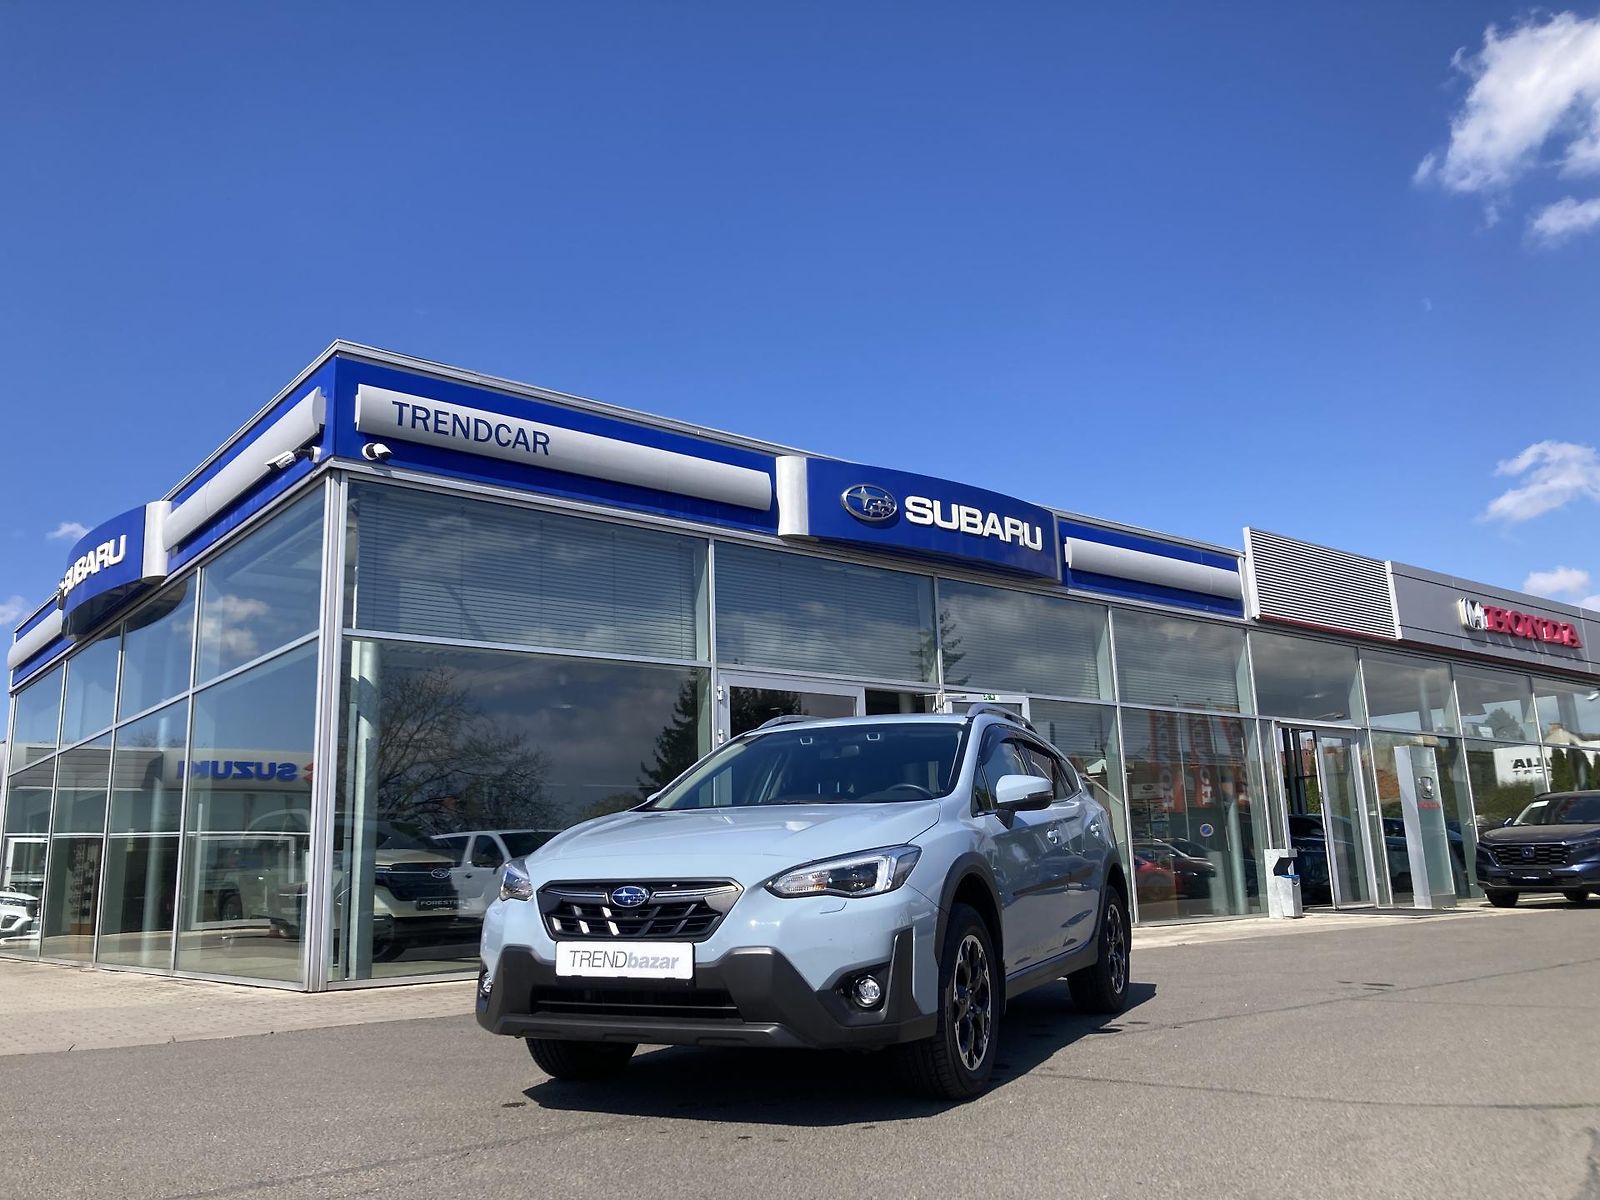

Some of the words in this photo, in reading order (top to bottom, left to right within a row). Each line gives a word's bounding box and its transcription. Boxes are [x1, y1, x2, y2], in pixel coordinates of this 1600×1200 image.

[391, 400, 551, 456] TRENDCAR
[904, 495, 1043, 551] SUBARU
[1482, 604, 1583, 648] HONDA
[569, 950, 680, 969] TRENDbazar
